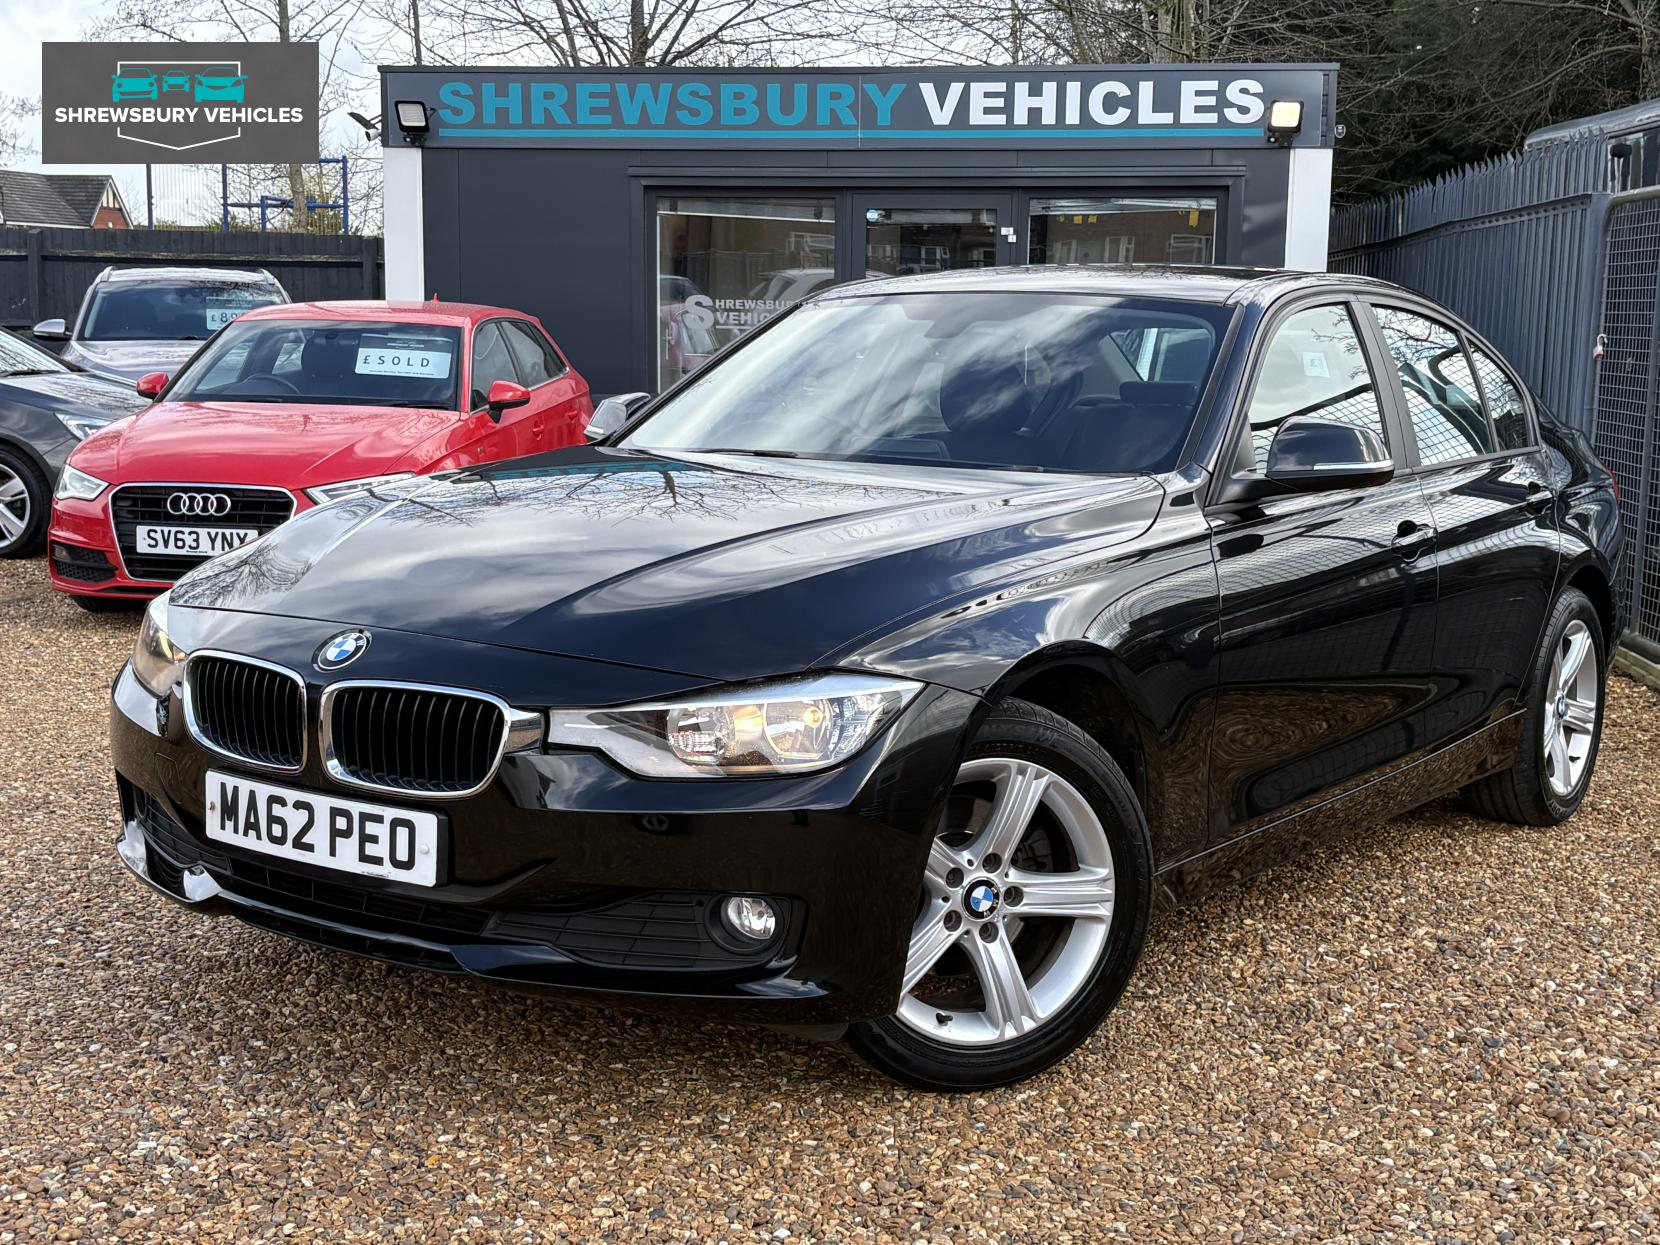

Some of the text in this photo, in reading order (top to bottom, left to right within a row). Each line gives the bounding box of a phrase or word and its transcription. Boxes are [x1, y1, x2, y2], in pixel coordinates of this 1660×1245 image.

[438, 79, 1265, 126] SHREWSBURY VEHICLES
[147, 528, 248, 552] SV63 YNY
[220, 782, 416, 871] MA62 PEO
